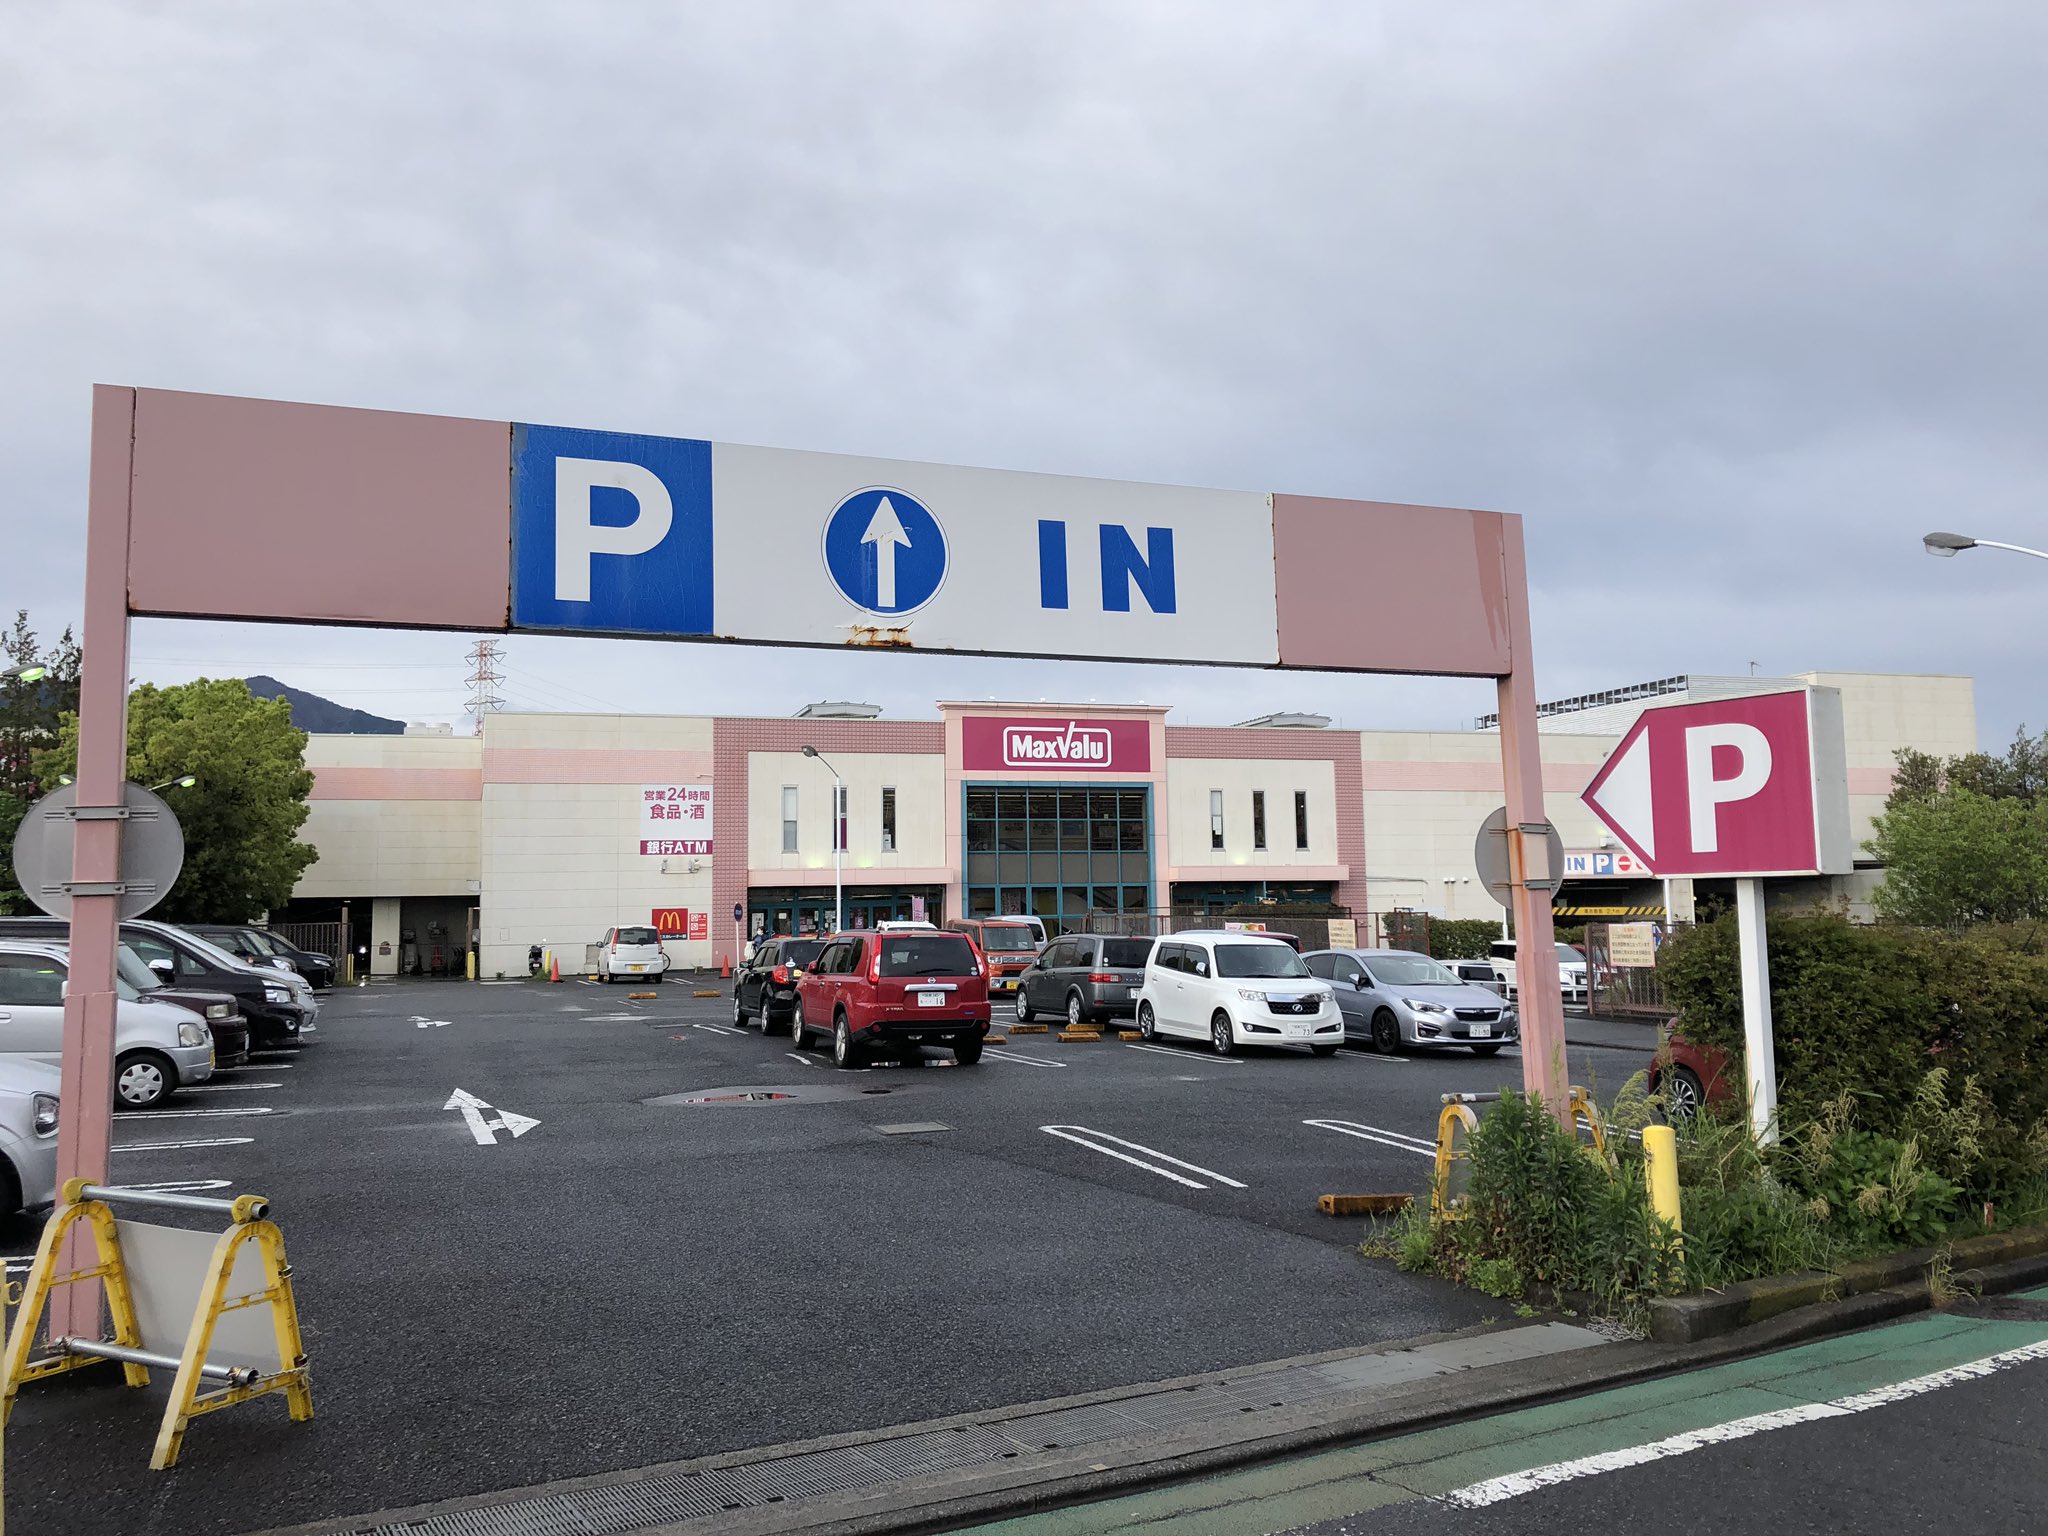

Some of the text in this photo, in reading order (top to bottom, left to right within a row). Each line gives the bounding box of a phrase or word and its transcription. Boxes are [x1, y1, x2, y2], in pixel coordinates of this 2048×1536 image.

[555, 456, 1177, 614] P IN
[1012, 721, 1104, 760] MaxValu
[644, 787, 710, 801] 営業24時間
[1685, 723, 1773, 853] P
[650, 804, 705, 820] 食品・酒
[646, 841, 707, 854] 銀行ATM
[1567, 854, 1610, 873] IN P
